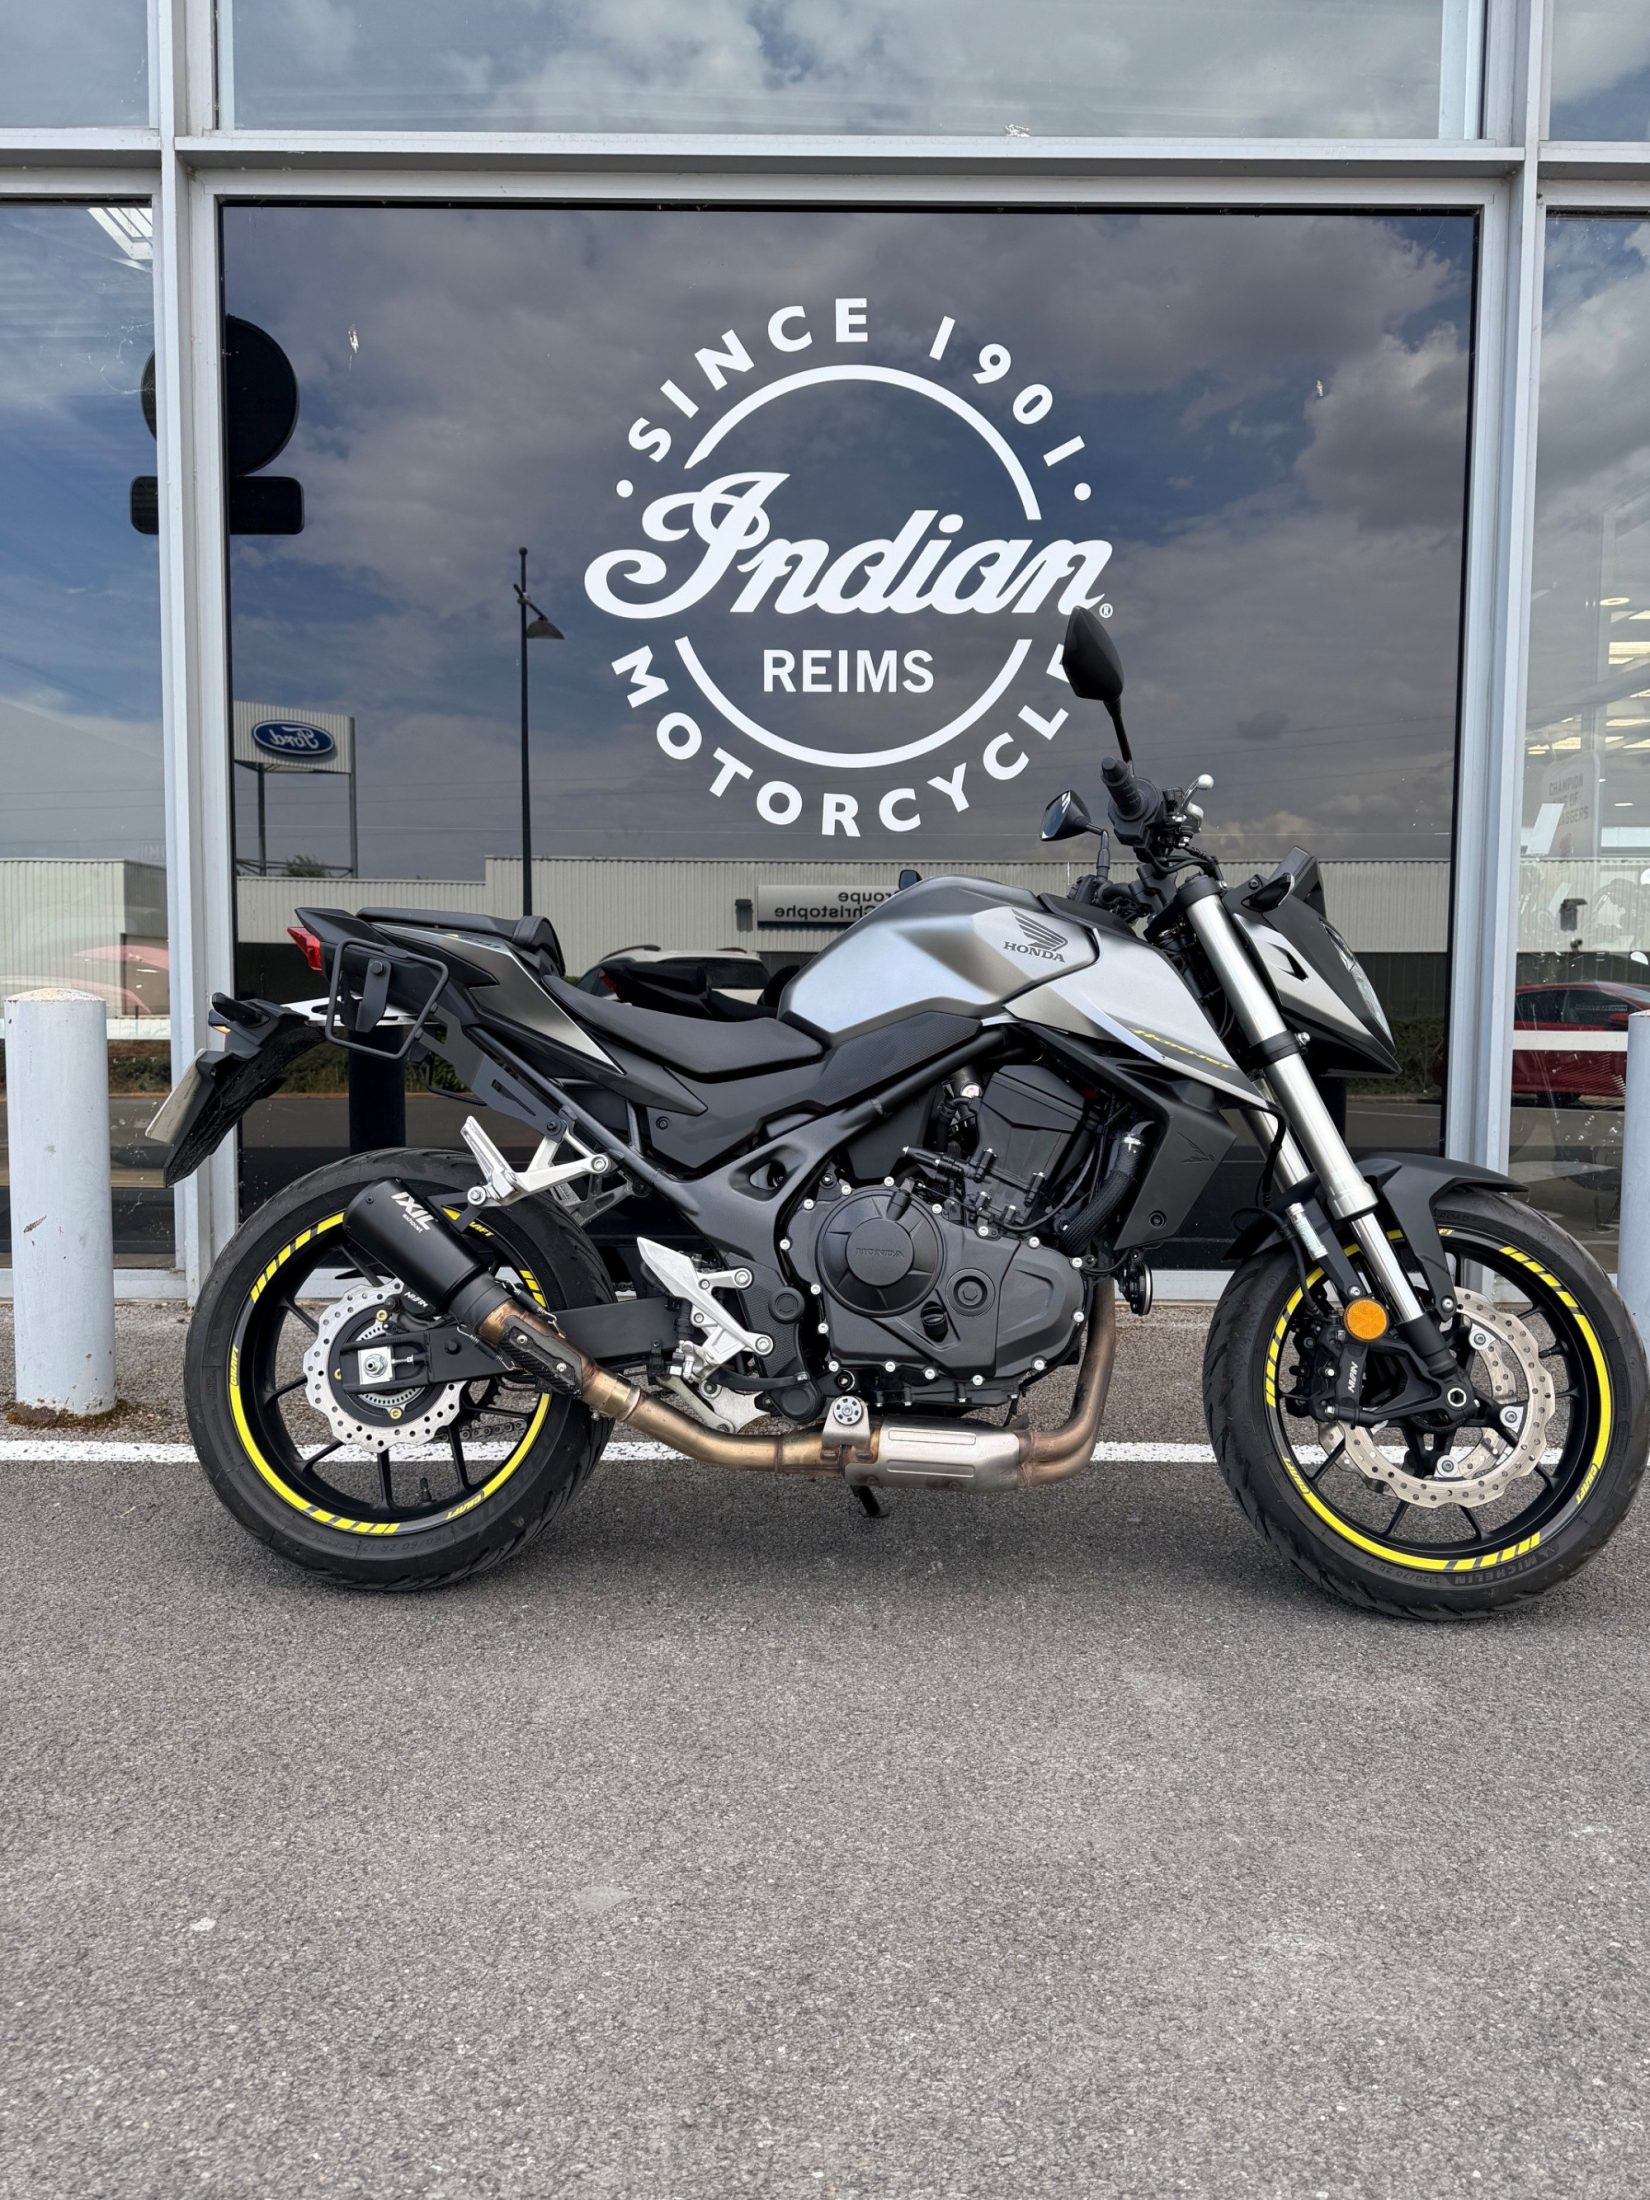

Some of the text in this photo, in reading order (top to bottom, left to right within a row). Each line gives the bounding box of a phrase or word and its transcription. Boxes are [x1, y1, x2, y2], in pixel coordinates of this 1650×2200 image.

[628, 297, 1085, 467] SINCE 1901
[584, 471, 1113, 619] Indian
[763, 649, 934, 693] REIMS
[1003, 940, 1066, 963] HONDA
[855, 1247, 905, 1258] HONDA
[1453, 1555, 1539, 1585] MICHELIN
